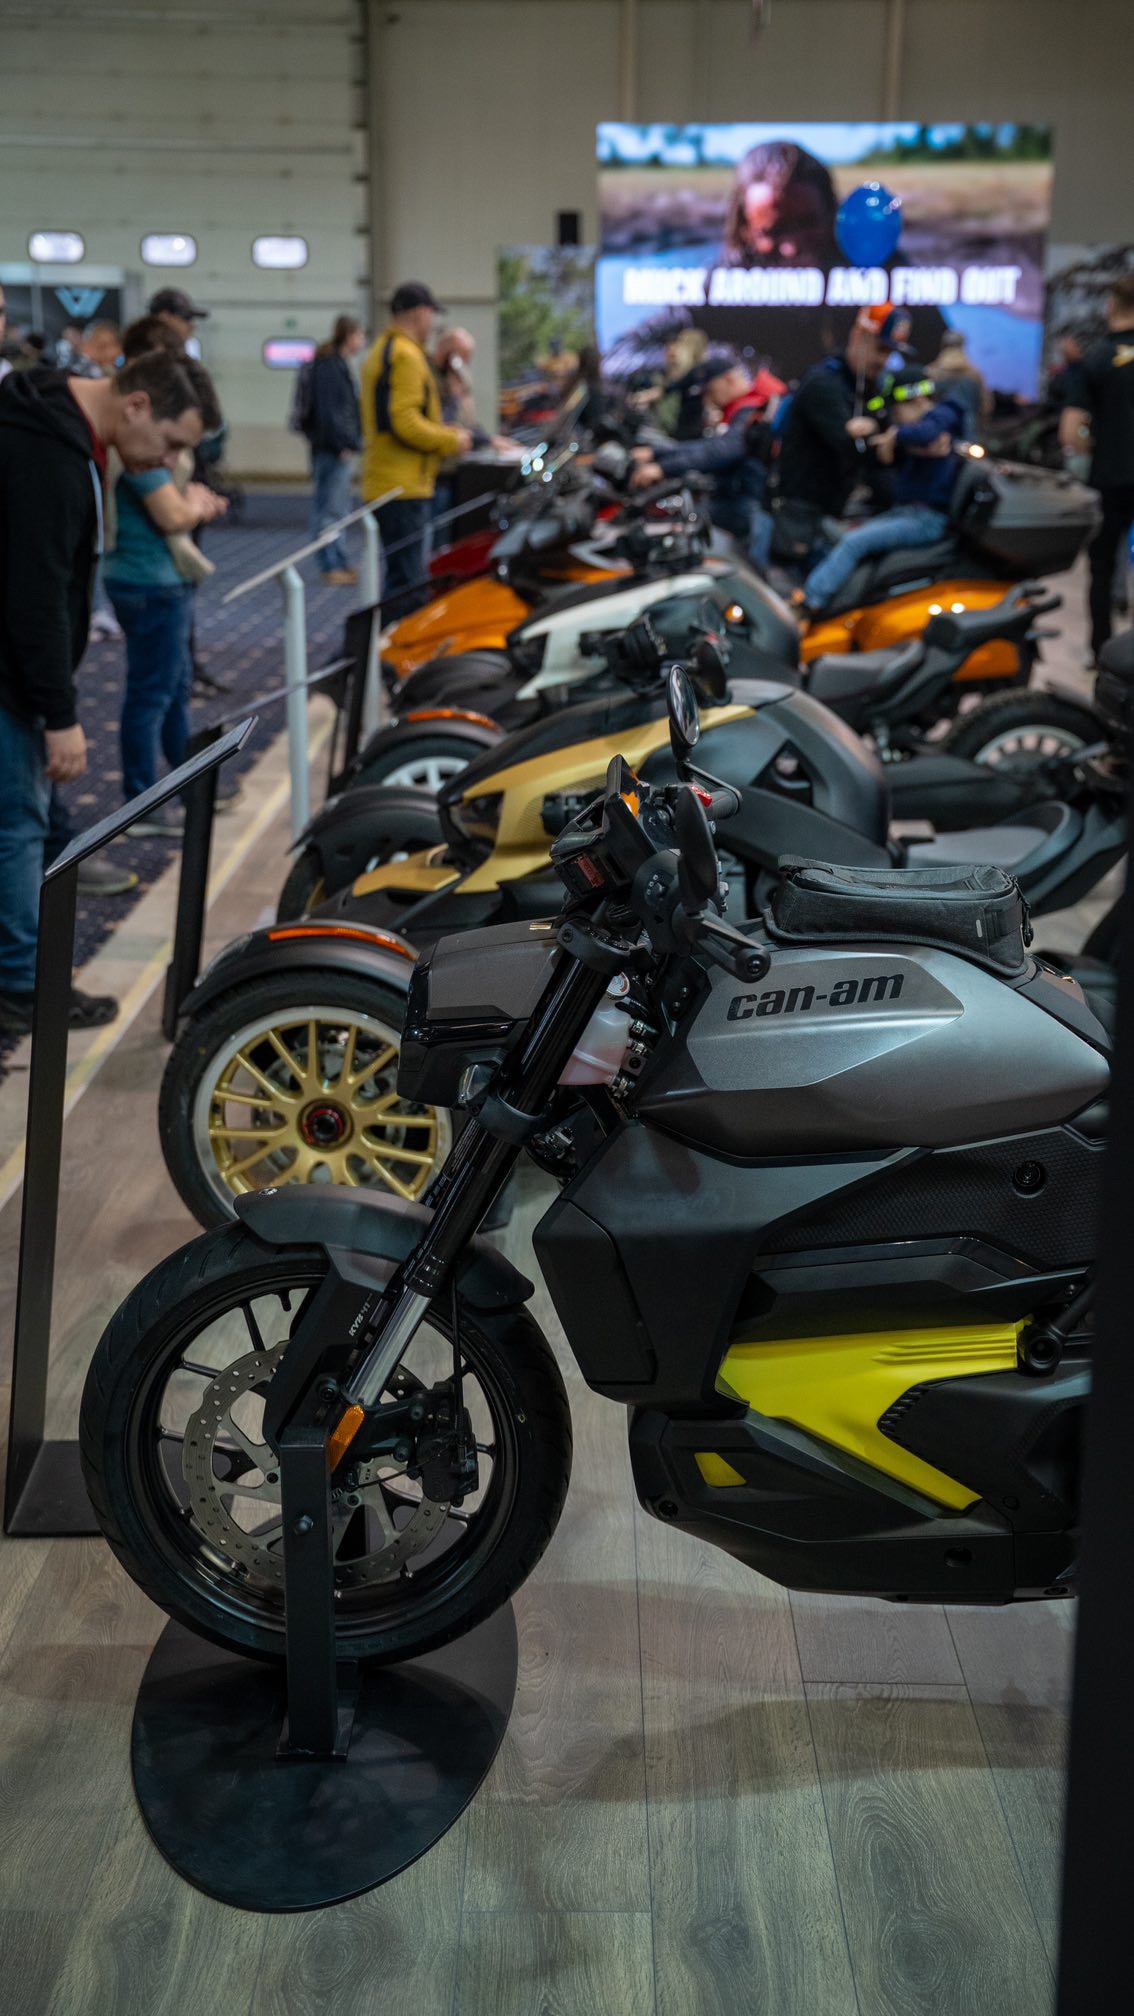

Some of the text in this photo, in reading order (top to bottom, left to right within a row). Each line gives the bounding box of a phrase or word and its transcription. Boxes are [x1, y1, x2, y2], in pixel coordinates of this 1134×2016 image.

[709, 266, 825, 306] AROUND
[826, 266, 889, 306] AND
[891, 266, 959, 305] FIND
[961, 265, 1022, 304] OUT
[727, 973, 904, 1021] can-am
[348, 1313, 364, 1336] KYB
